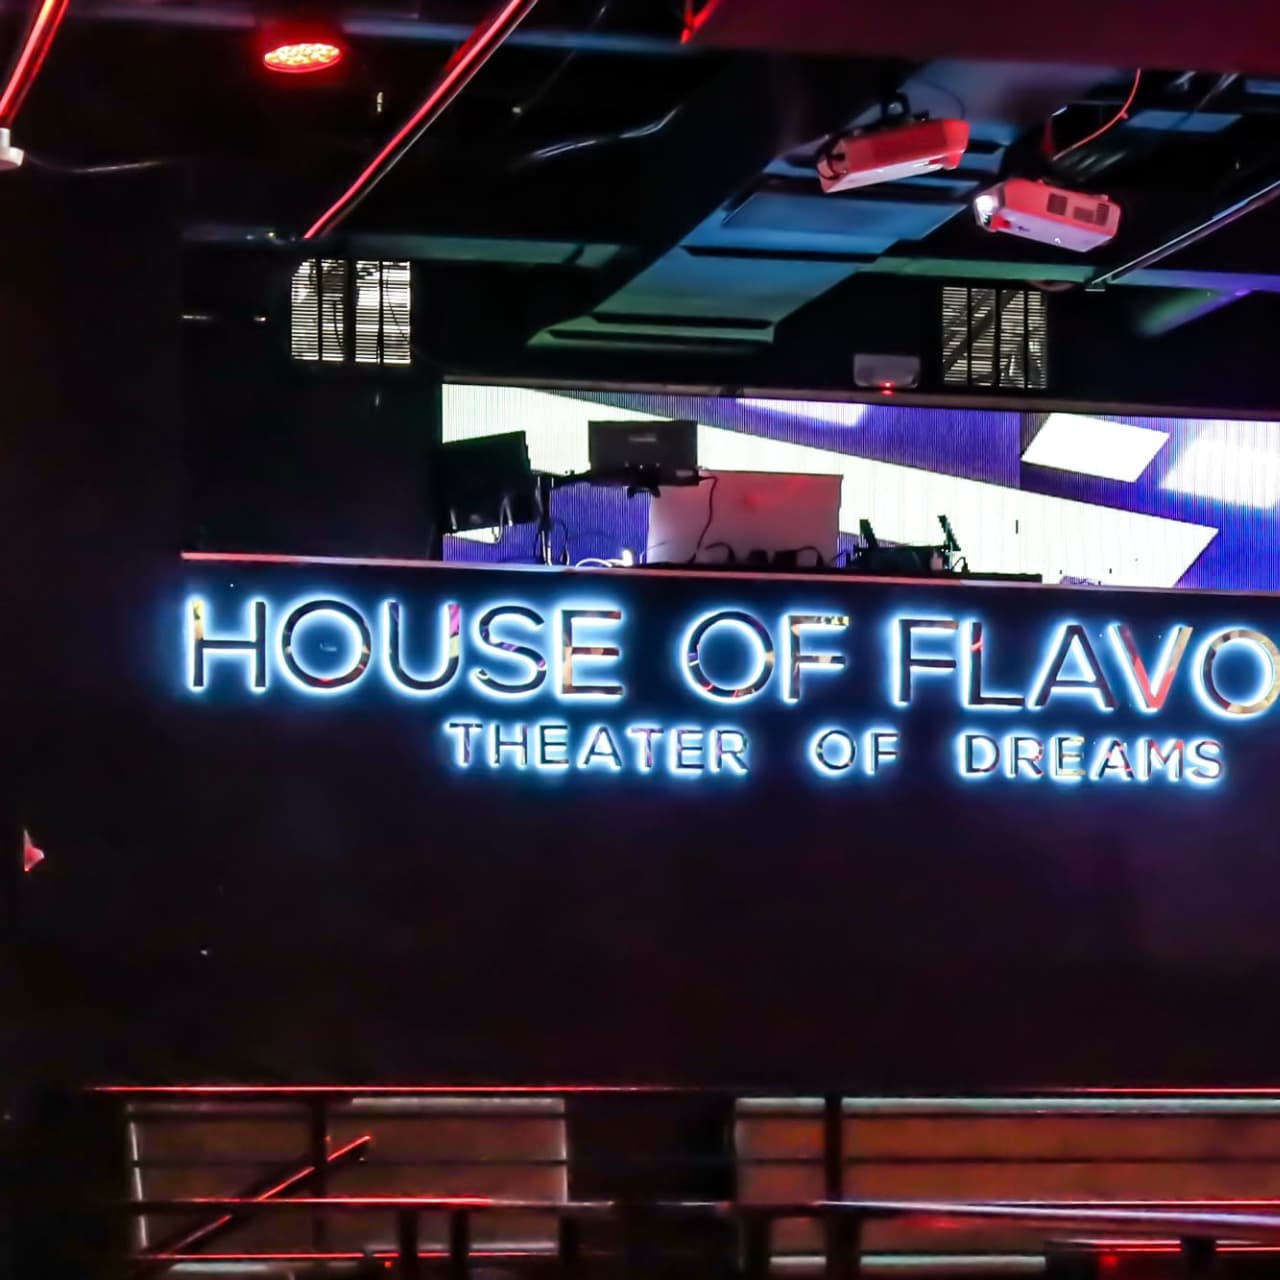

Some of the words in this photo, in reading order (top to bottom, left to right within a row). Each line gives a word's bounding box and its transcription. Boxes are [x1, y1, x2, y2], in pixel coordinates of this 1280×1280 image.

[187, 597, 624, 697] HOUSE
[683, 607, 850, 702] OF
[447, 720, 750, 774] THEATER
[812, 728, 900, 773] OF
[958, 732, 1226, 783] DREAMS
